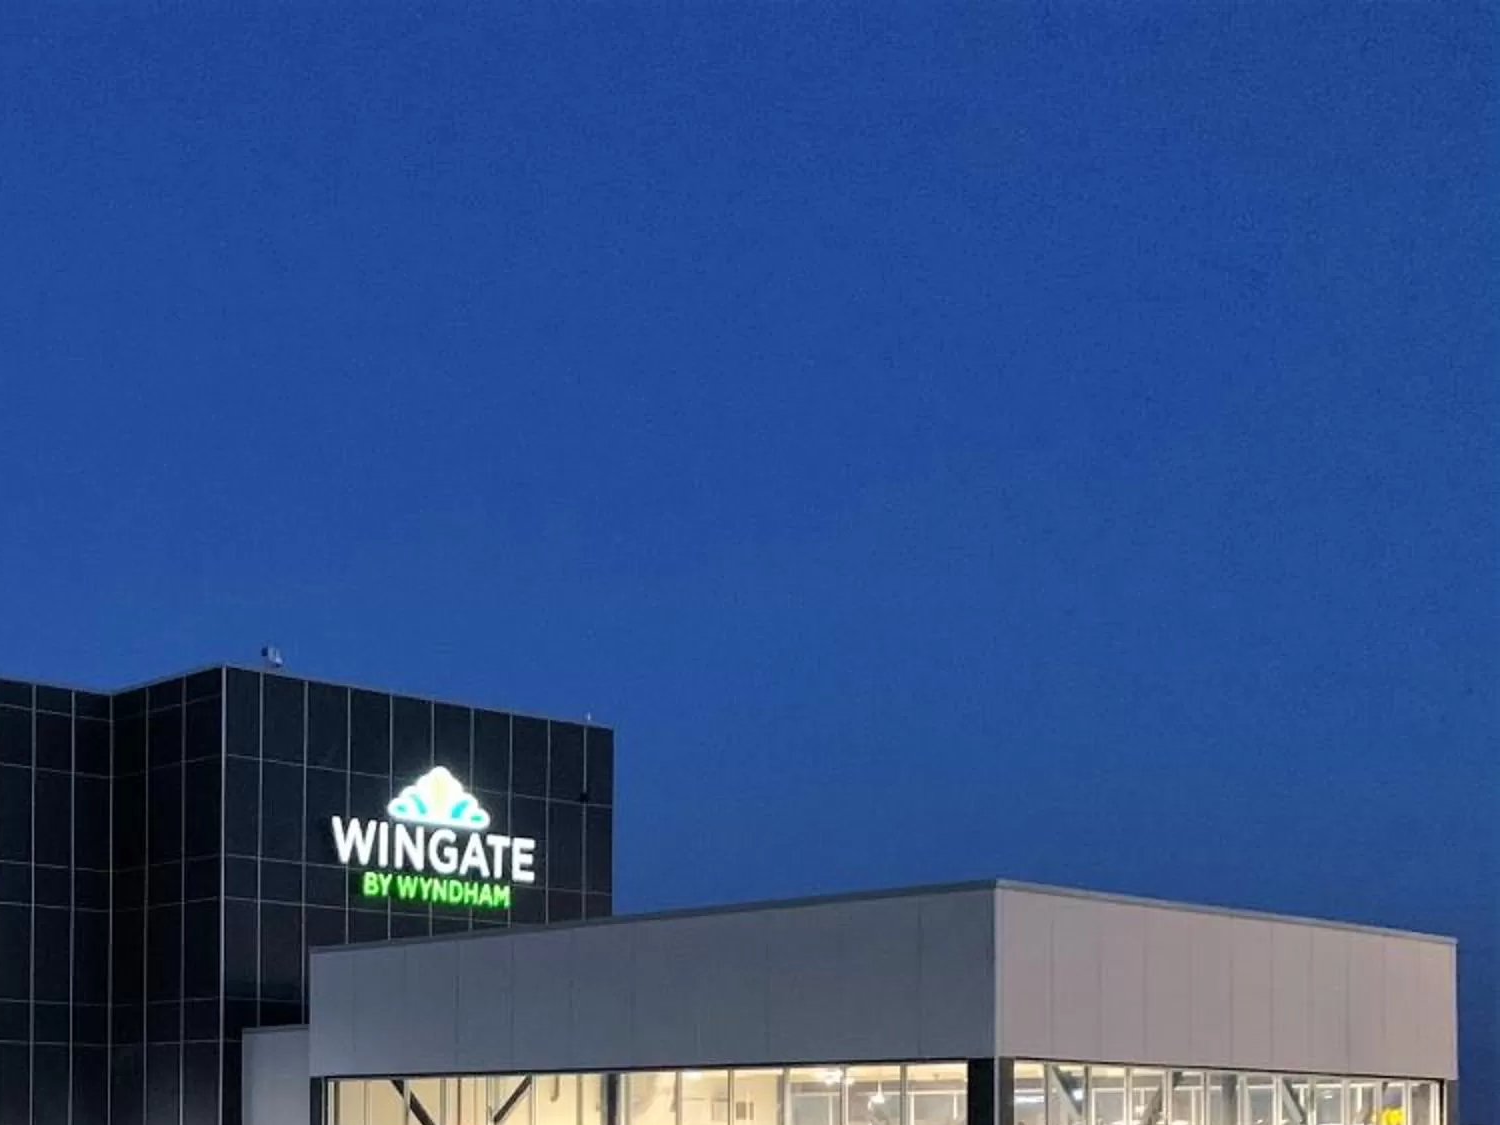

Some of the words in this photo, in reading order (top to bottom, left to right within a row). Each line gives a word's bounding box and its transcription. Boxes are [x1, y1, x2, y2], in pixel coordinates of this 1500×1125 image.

[331, 815, 536, 883] WINGATE
[363, 871, 392, 897] BY
[396, 875, 511, 909] WYNDHAM
